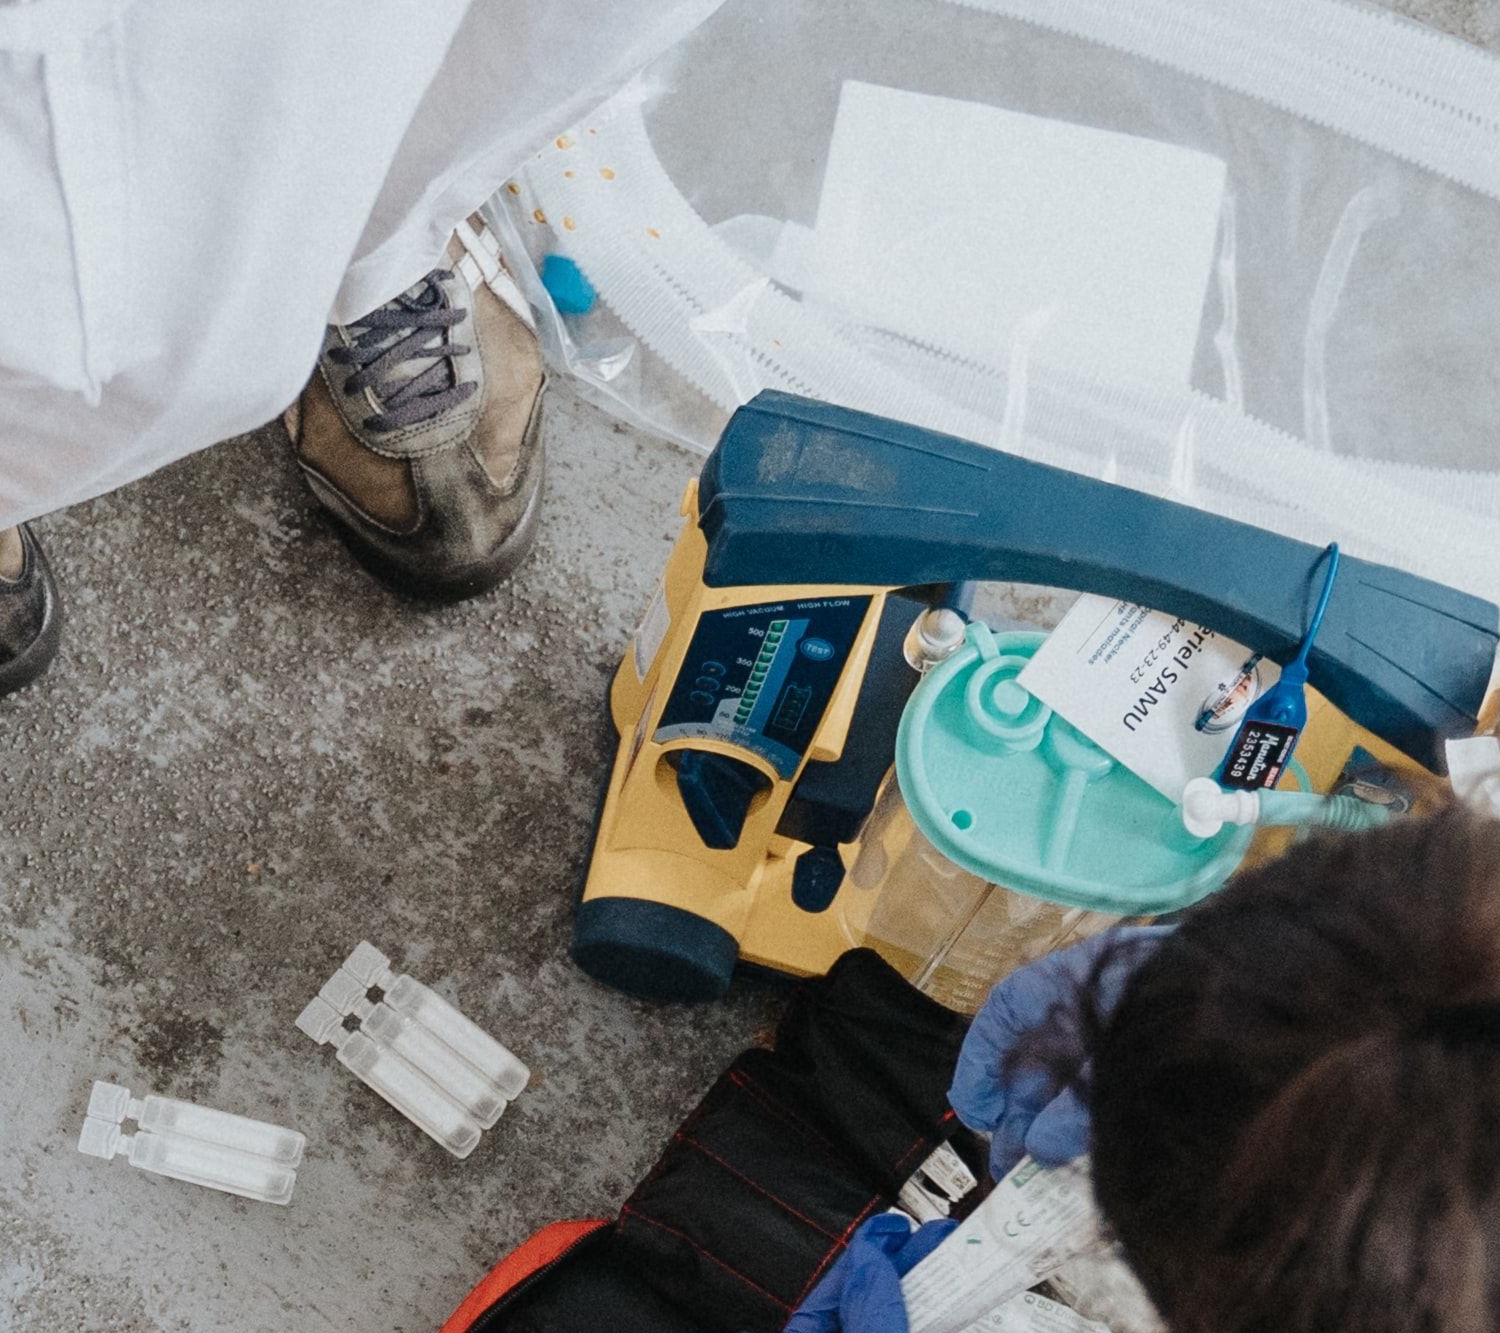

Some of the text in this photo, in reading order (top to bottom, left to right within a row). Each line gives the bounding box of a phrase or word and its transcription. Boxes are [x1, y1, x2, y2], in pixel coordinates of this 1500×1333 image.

[747, 605, 784, 615] VACUUM
[797, 599, 850, 609] HIGH FLOW
[747, 626, 765, 637] 500
[805, 643, 830, 656] TEST
[1086, 626, 1121, 666] malades
[1101, 630, 1130, 666] Necker
[735, 656, 752, 668] 350
[1120, 625, 1216, 732] ériel SAMU
[724, 683, 741, 695] 200
[1229, 728, 1260, 779] 2353439
[1243, 730, 1280, 785] Manutan
